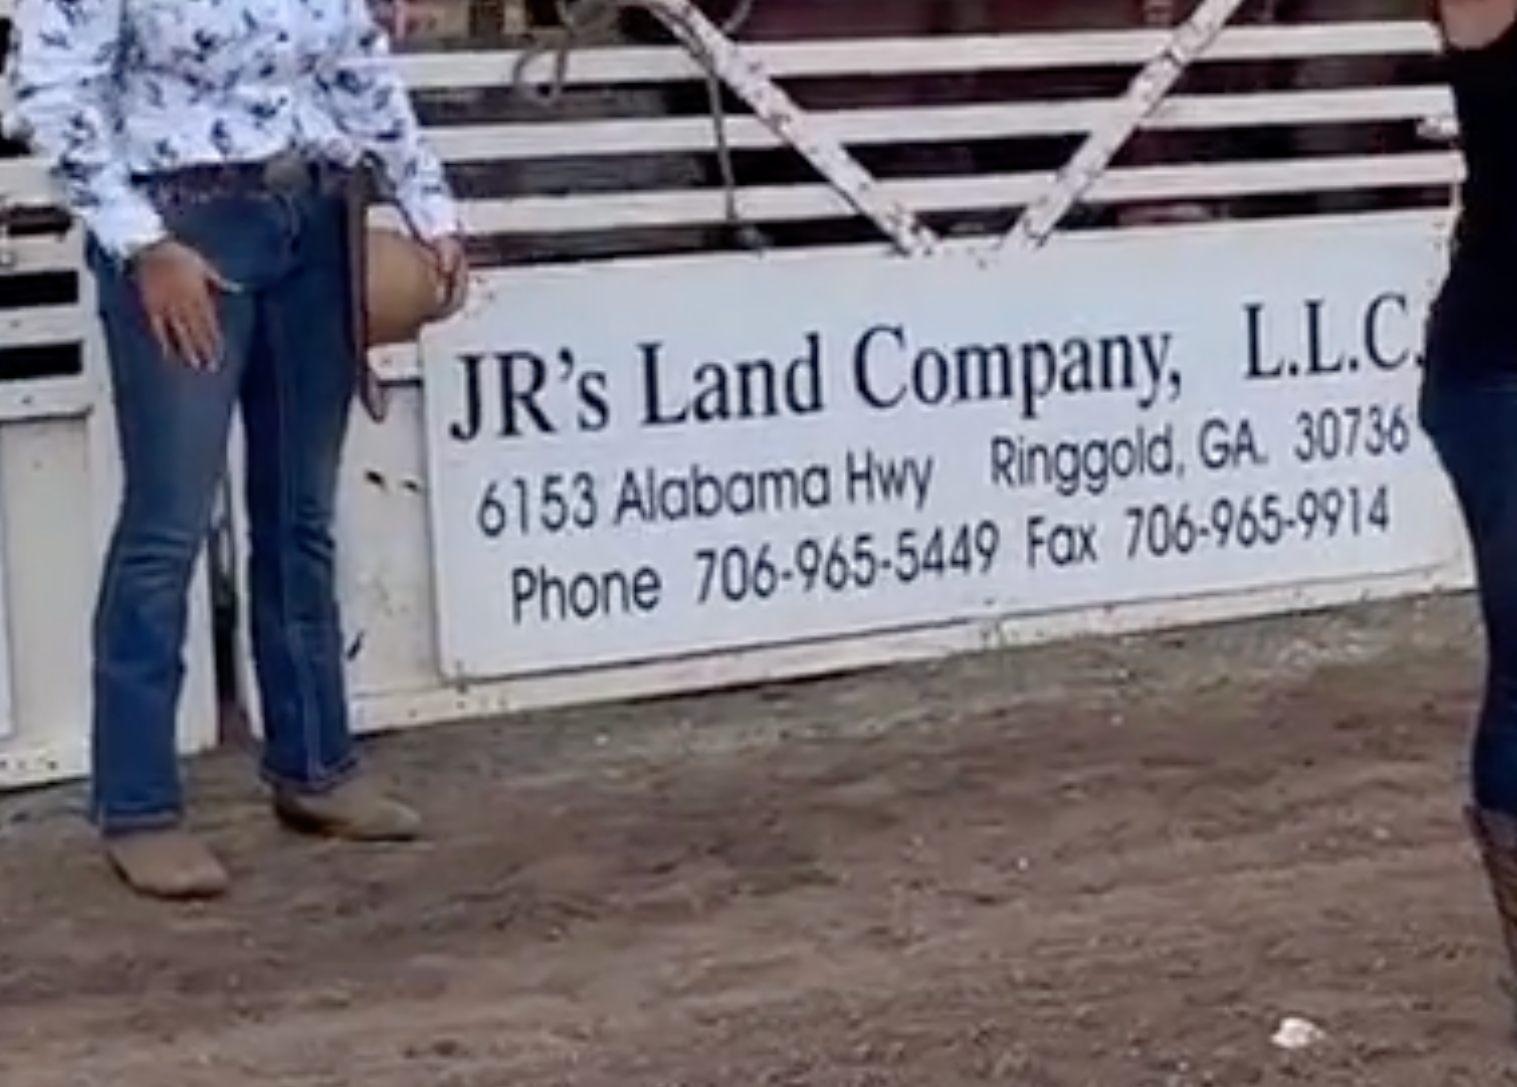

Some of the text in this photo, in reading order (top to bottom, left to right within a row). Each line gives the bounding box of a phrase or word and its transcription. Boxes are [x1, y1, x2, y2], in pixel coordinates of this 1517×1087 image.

[636, 330, 826, 427] Land
[852, 324, 1183, 421] Company,
[1242, 292, 1427, 381] L.L.C.
[476, 404, 1410, 539] 6153 Alabama Hwy Ringgold, GA. 30736
[510, 484, 1390, 625] Phone 706-965-5449 Fax 706-965-9914
